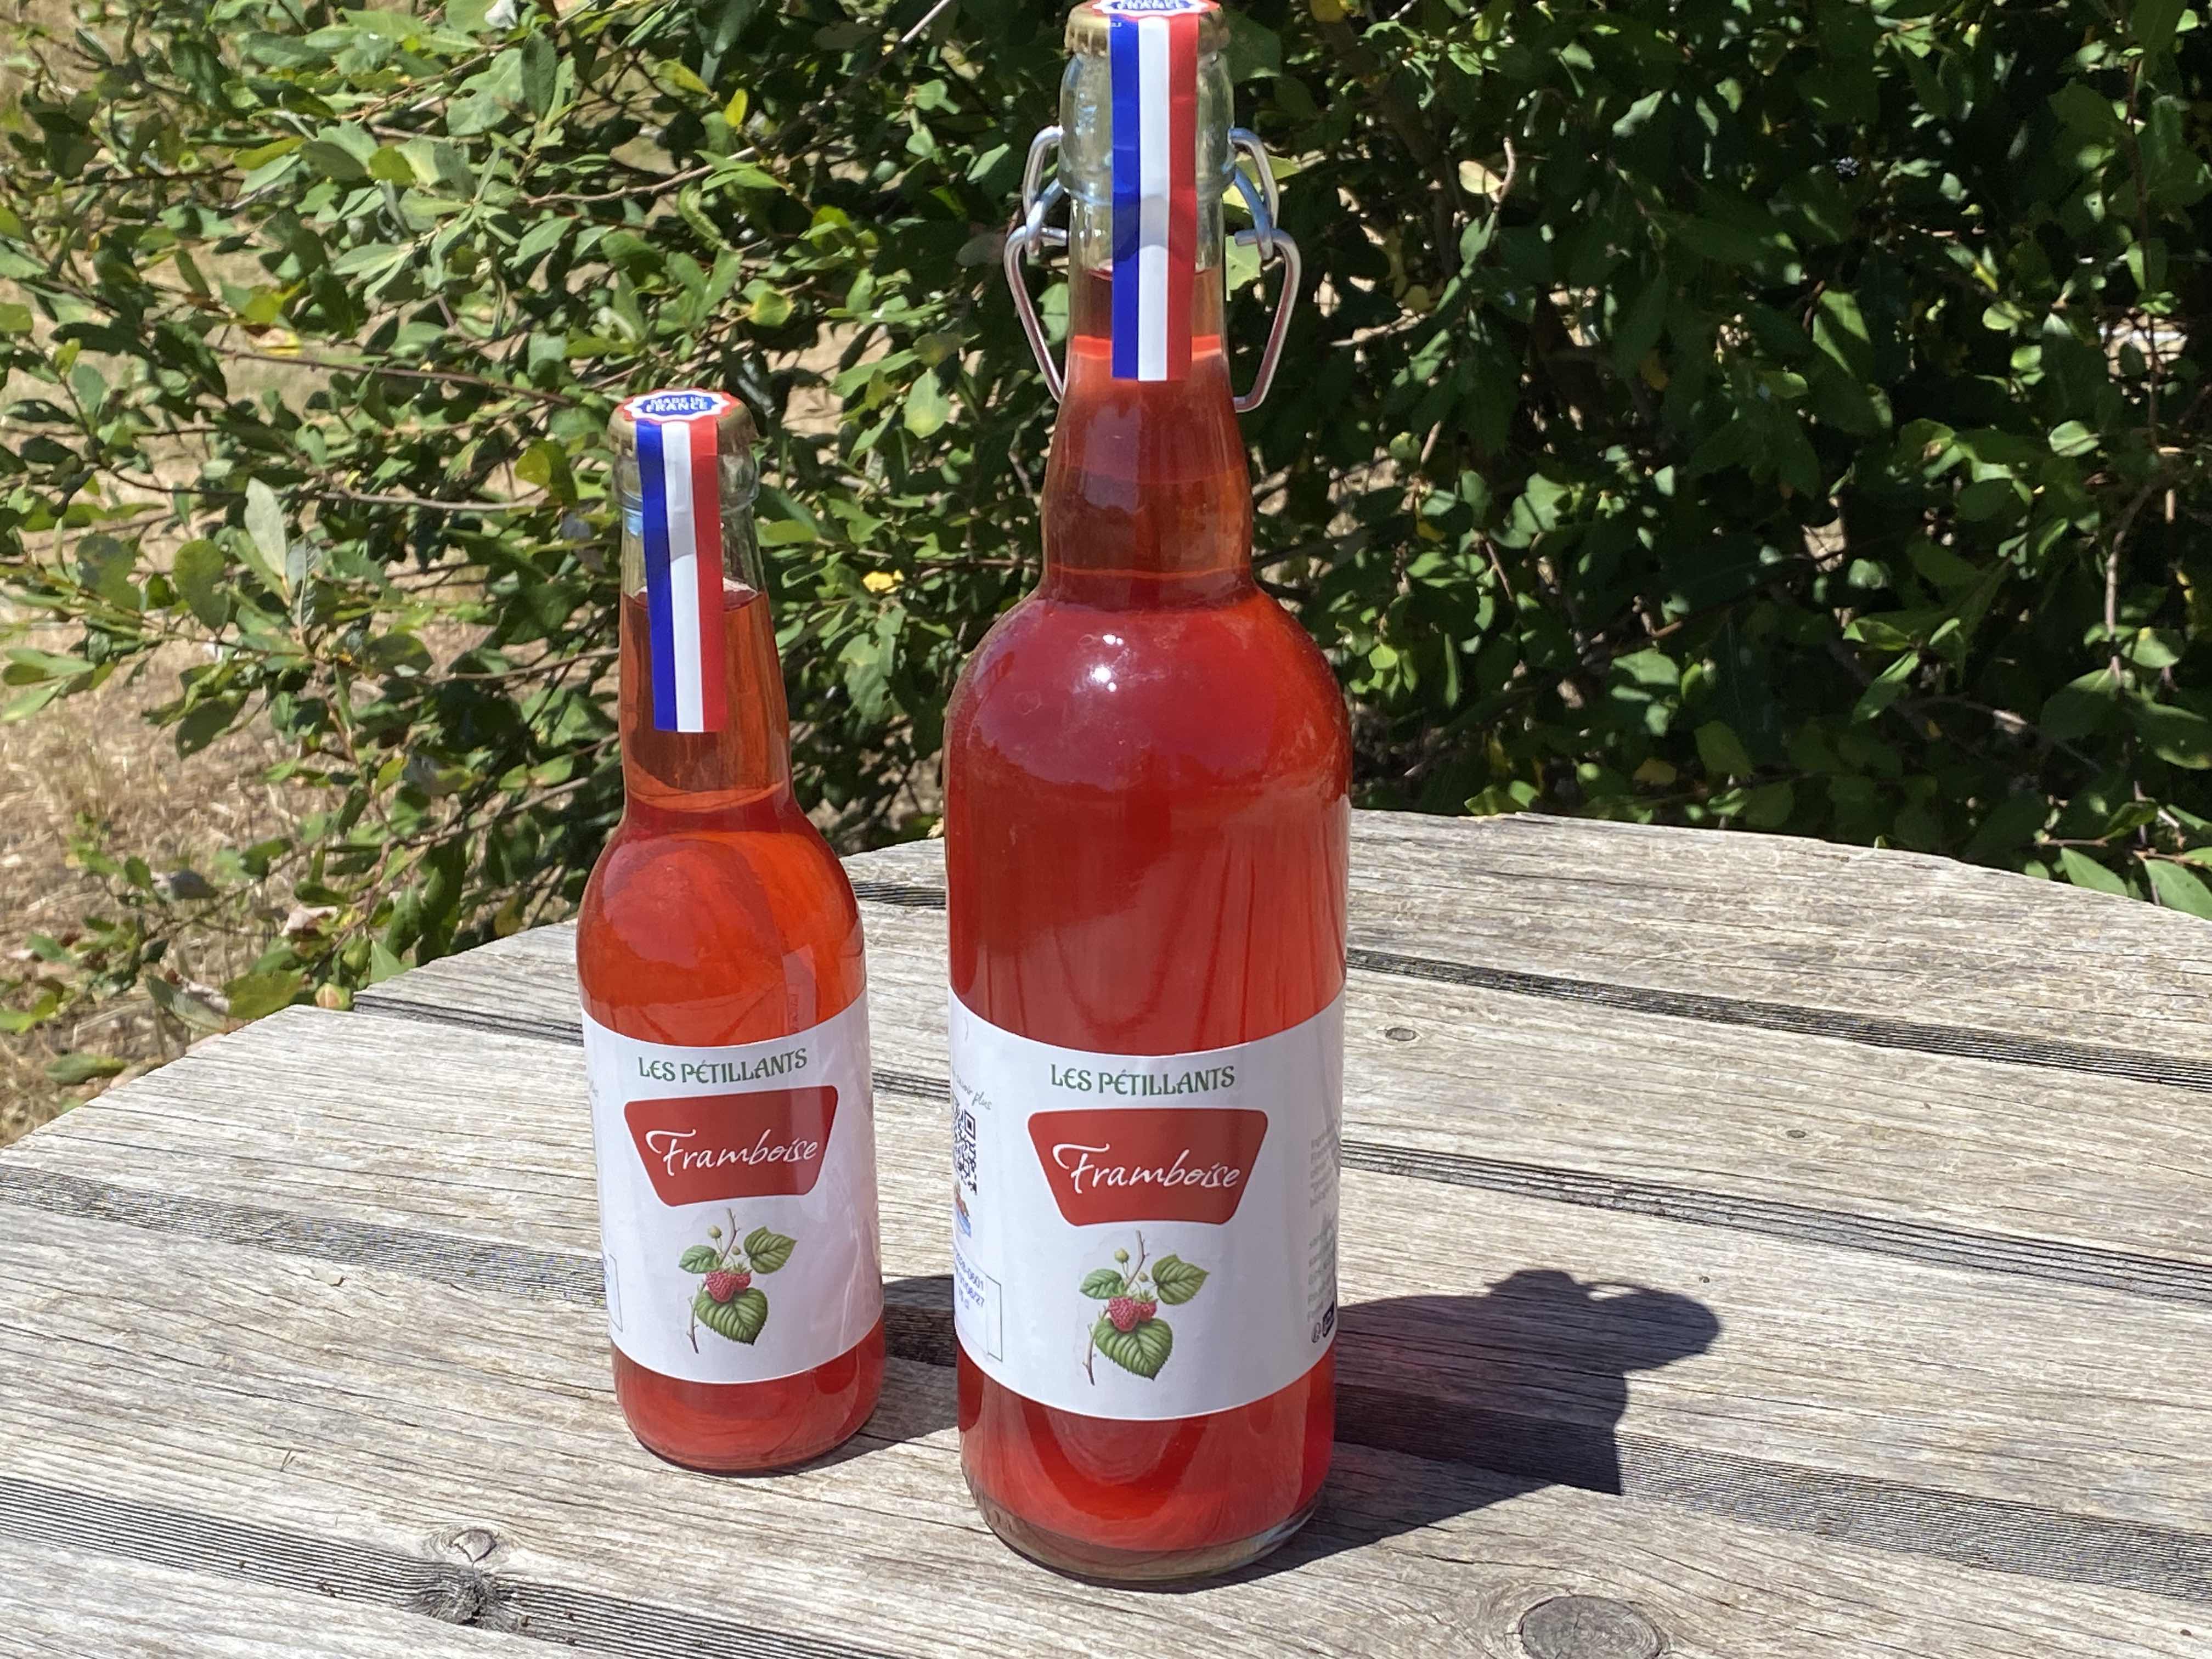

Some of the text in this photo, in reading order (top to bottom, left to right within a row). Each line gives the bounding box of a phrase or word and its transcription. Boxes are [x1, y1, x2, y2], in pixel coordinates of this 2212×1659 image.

[646, 400, 708, 413] FRANCE
[638, 1047, 808, 1084] LES PÉTILLANTS
[1051, 1063, 1235, 1096] LES PÉTILLANTS
[645, 1128, 819, 1177] Framboise
[1052, 1143, 1241, 1194] Framboise
